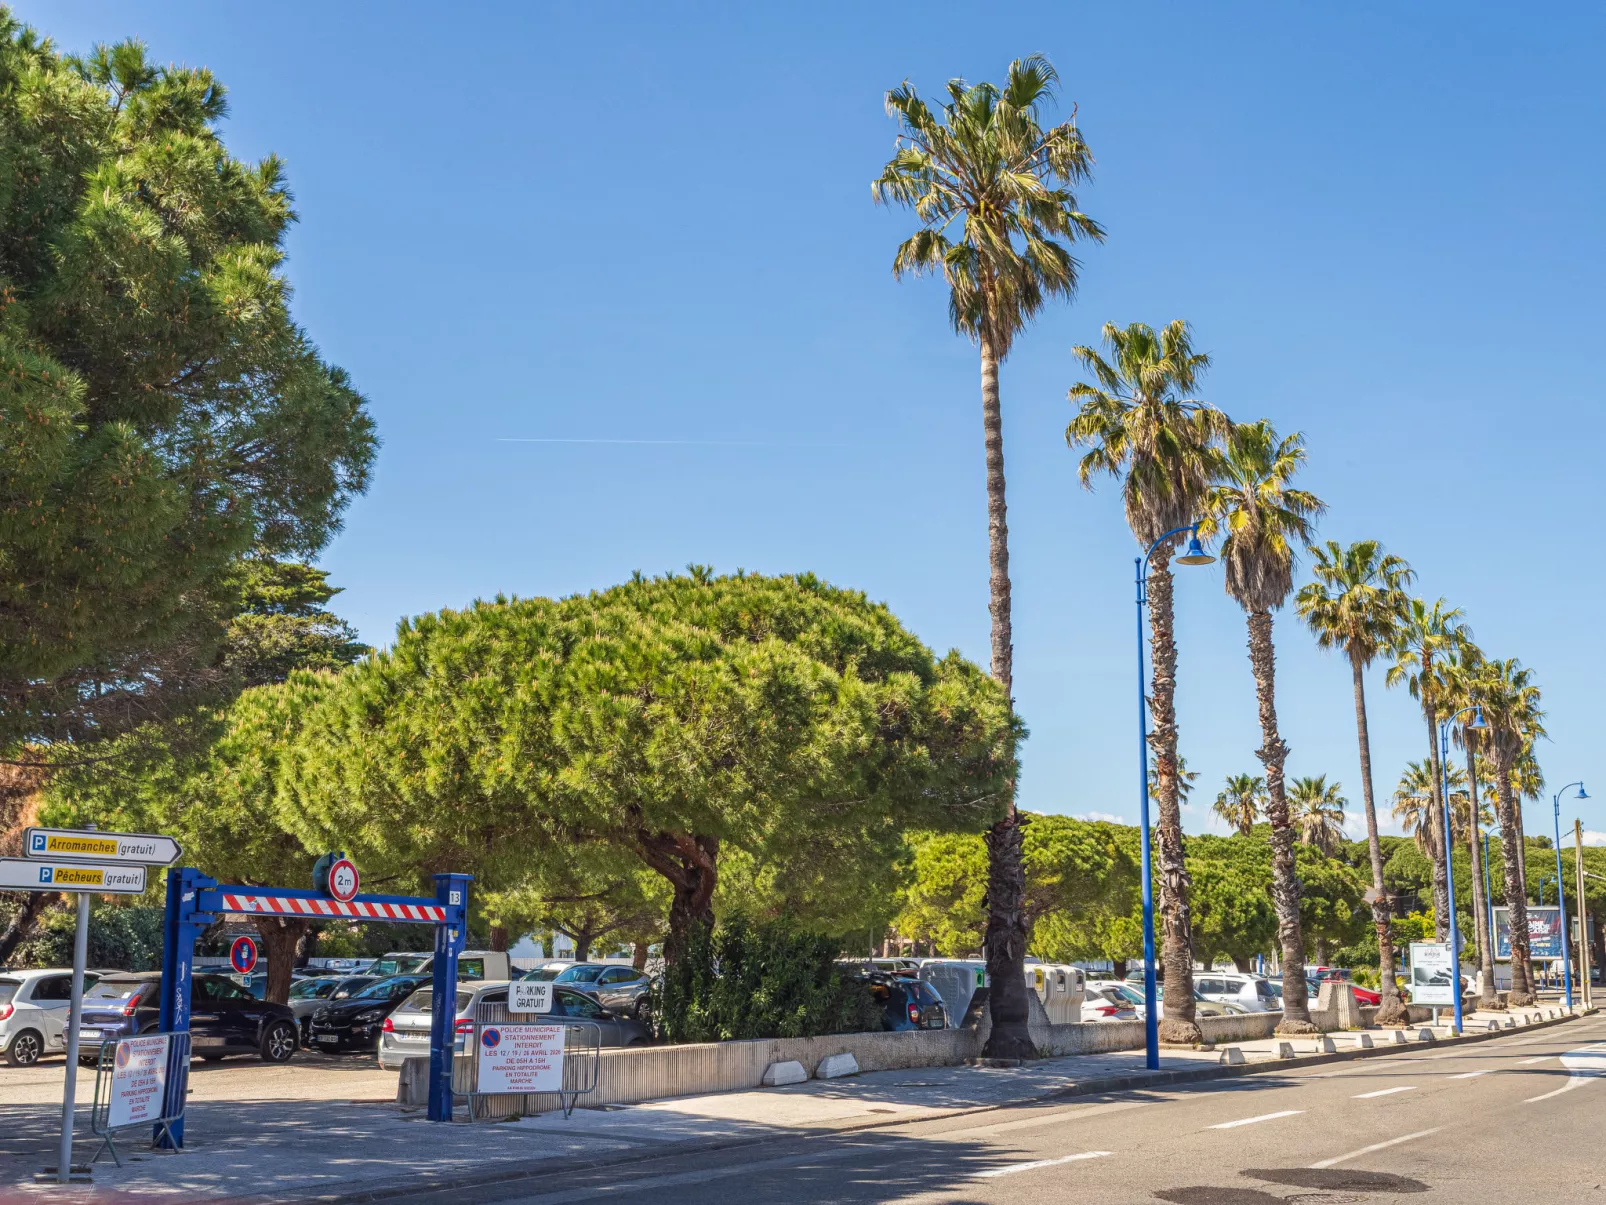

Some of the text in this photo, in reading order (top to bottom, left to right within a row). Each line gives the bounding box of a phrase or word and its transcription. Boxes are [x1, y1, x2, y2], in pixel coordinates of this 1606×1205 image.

[49, 838, 115, 852] Arromanches
[118, 842, 156, 856] (gratuit)
[55, 870, 101, 883] Pêcheurs
[104, 872, 141, 886] (gratuit)
[451, 893, 460, 903] 13
[516, 985, 546, 996] PRKING
[516, 998, 545, 1008] GRATUIT
